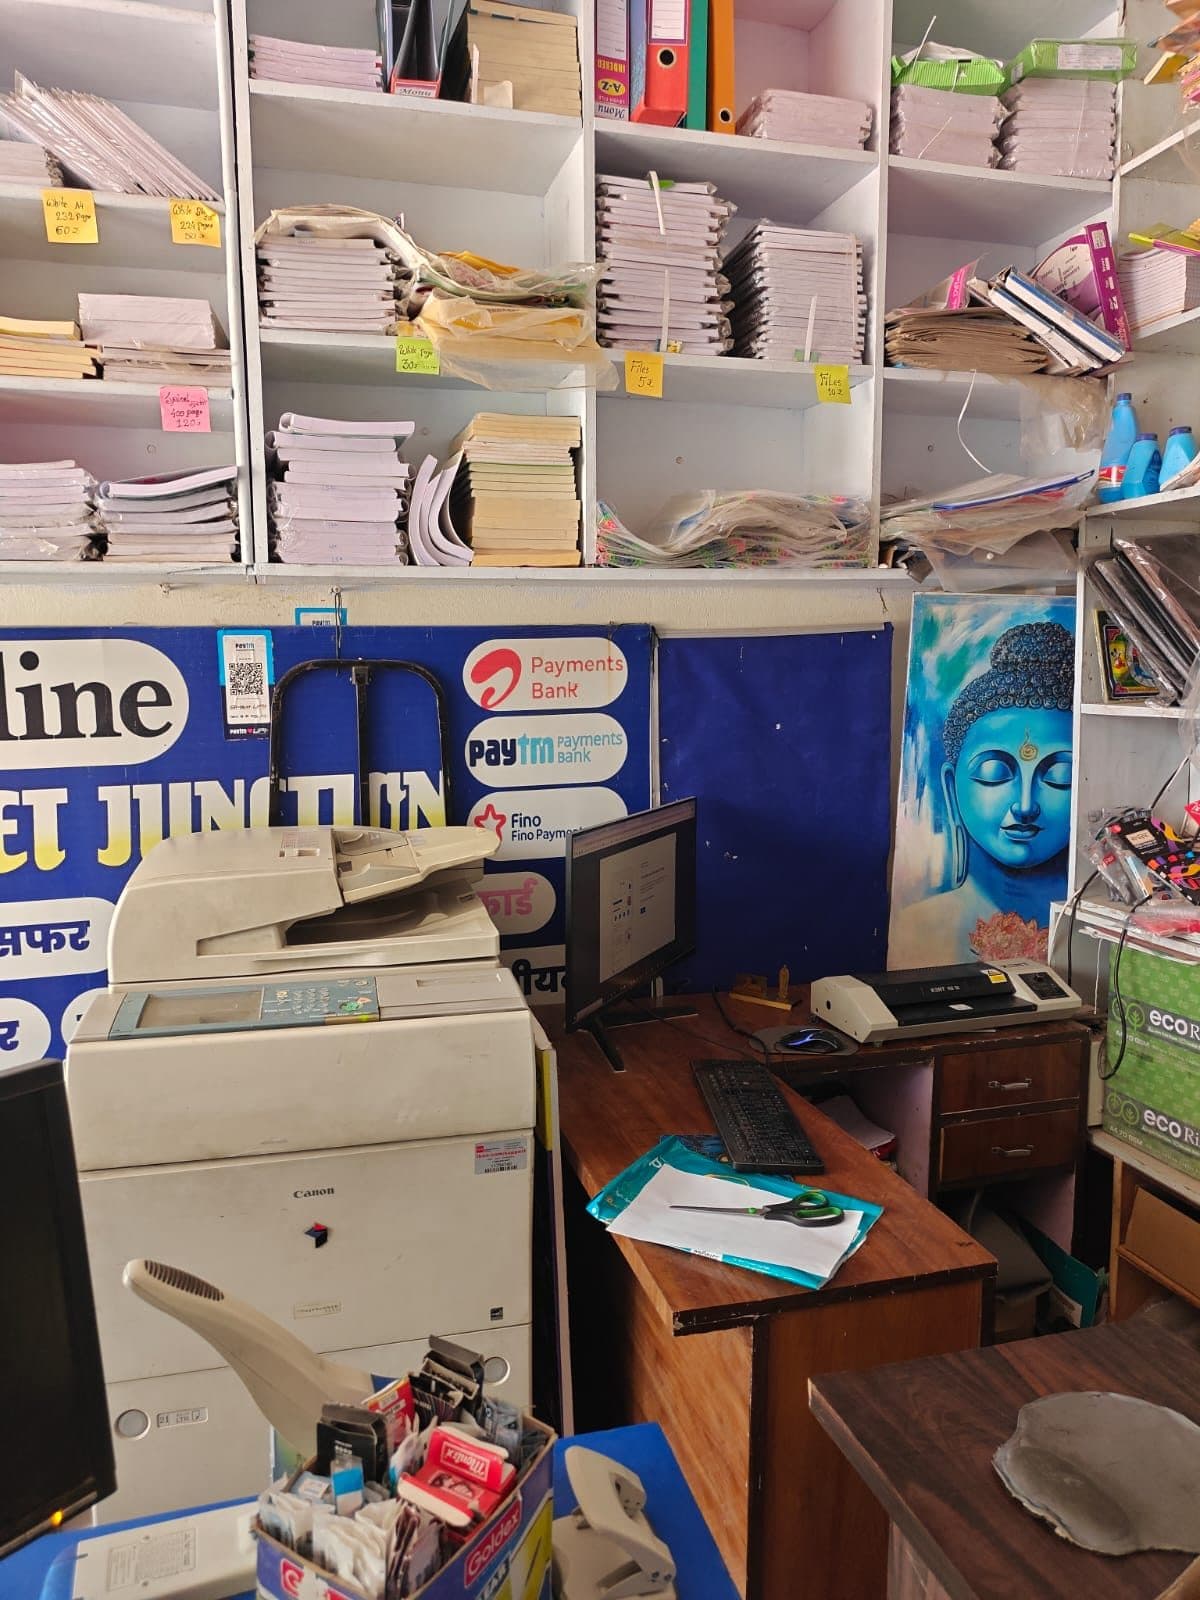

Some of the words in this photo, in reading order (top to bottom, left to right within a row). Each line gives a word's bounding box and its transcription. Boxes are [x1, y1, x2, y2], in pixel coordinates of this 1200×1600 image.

[600, 80, 622, 94] A-Z
[598, 104, 625, 119] Monu
[531, 656, 624, 677] Payments
[532, 681, 579, 699] Bank
[511, 813, 542, 828] Fino
[511, 829, 534, 842] Fino
[293, 1186, 335, 1199] Canon
[468, 1508, 521, 1577] Goldex
